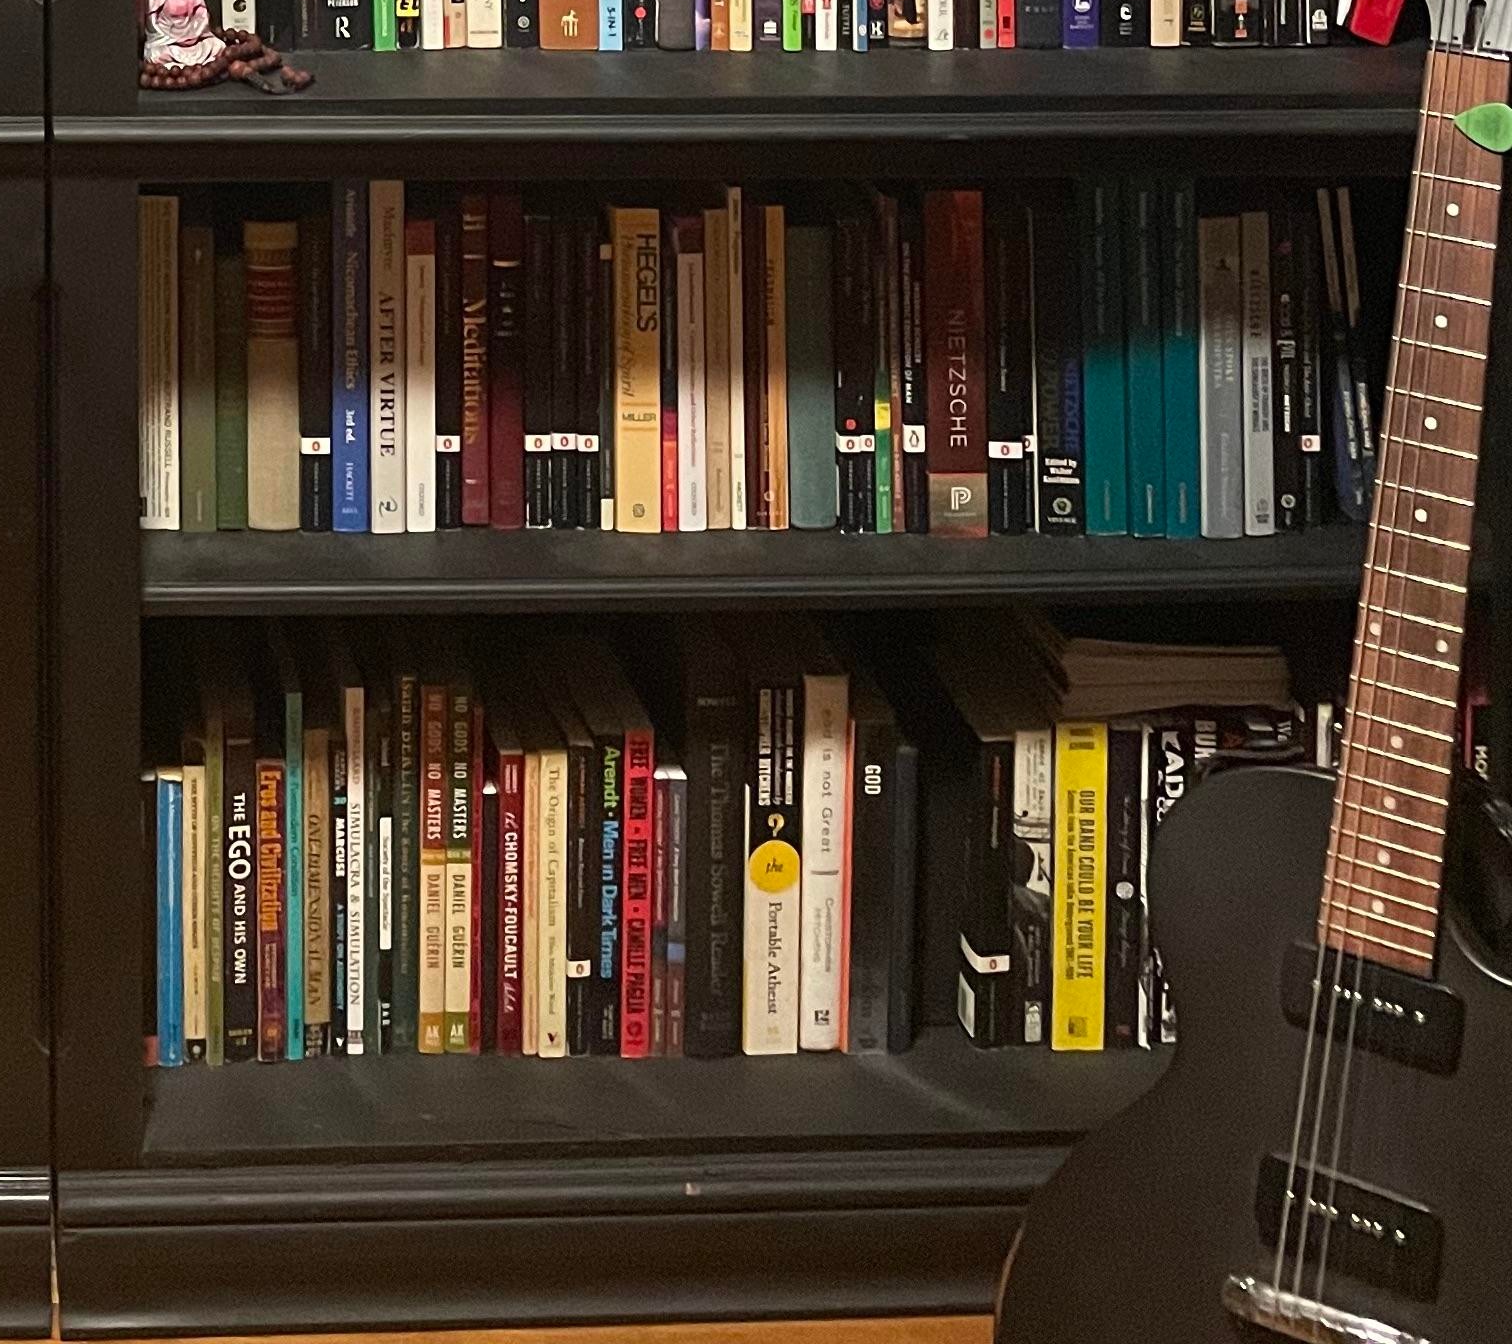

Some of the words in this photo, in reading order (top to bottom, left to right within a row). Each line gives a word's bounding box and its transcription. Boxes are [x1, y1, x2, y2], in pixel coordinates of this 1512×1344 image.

[637, 234, 657, 331] HEGEL'S
[379, 291, 396, 364] AFTER
[947, 309, 968, 448] NIETZSCHE
[379, 373, 396, 456] VIRTUE
[602, 746, 620, 808] Arendt
[864, 765, 882, 795] GOD
[233, 793, 247, 821] THE
[1080, 790, 1096, 815] OUR
[228, 825, 252, 879] EGO
[602, 821, 619, 858] Men
[1080, 819, 1095, 852] BAND
[602, 863, 618, 880] in
[1079, 856, 1095, 895] COULD
[234, 884, 247, 916] AND
[453, 874, 467, 914] DANIEL
[503, 832, 518, 979] CHOMSKY-FOUCAULT
[601, 885, 619, 926] Dark
[1080, 900, 1094, 915] BE
[234, 921, 247, 944] HIS
[453, 925, 470, 968] GUÉRIN
[1079, 919, 1094, 952] YOUR
[234, 949, 247, 984] OWN
[600, 929, 618, 979] Times
[1079, 955, 1094, 979] LIFE
